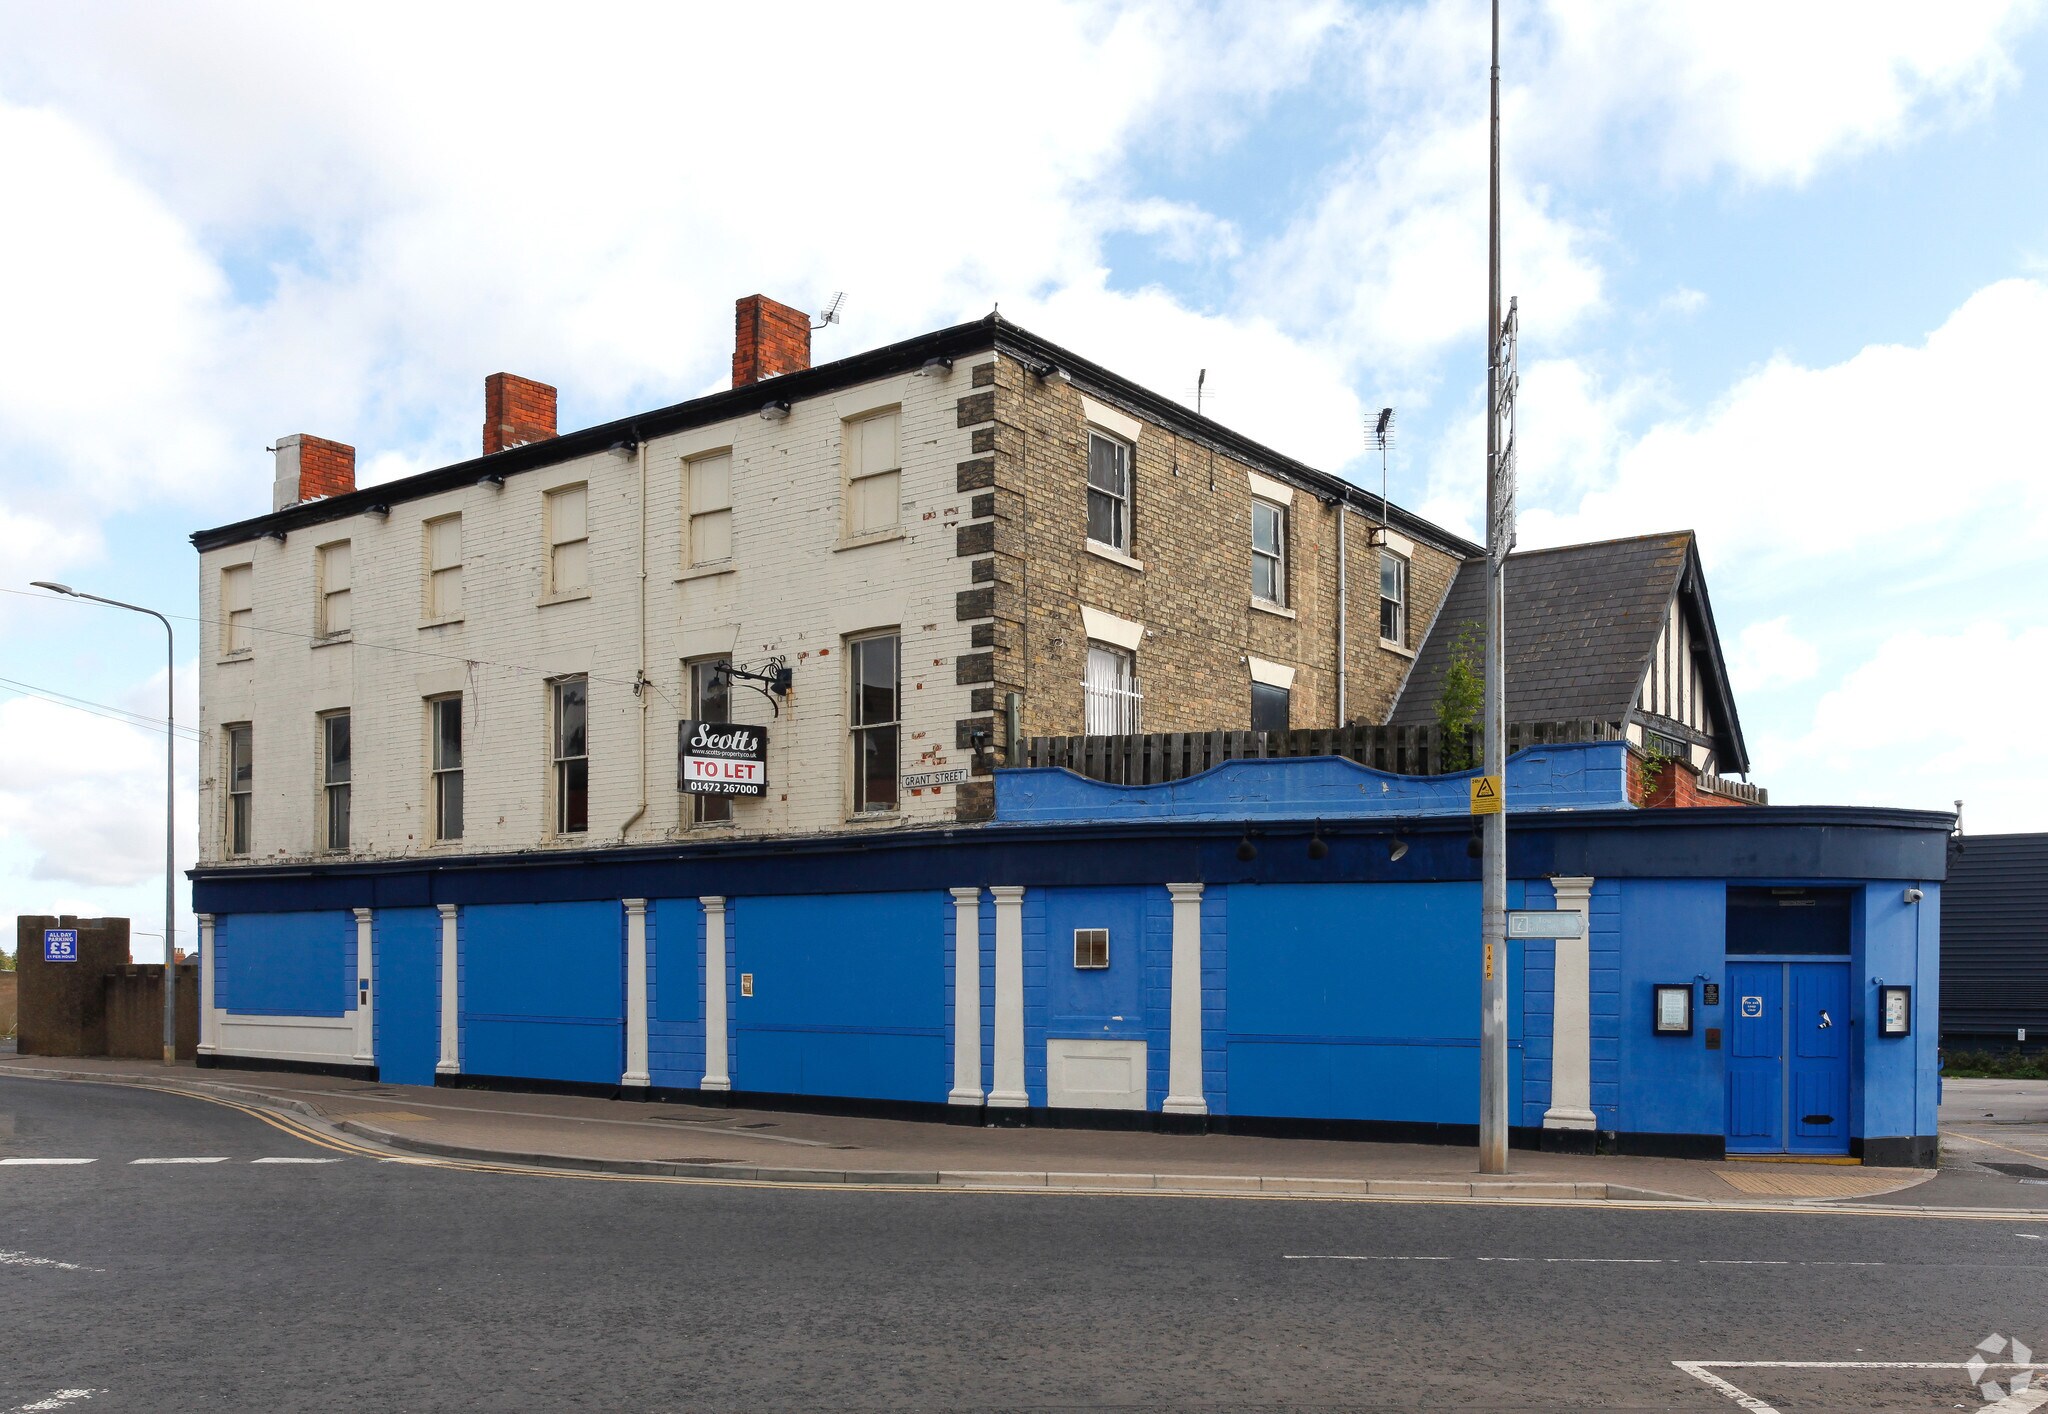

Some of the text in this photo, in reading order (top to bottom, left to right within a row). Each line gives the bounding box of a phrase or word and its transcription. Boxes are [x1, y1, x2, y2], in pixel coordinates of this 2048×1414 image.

[690, 723, 758, 751] Scotts
[691, 748, 757, 758] www.scotts-property.co.uk
[693, 761, 756, 779] TO LET
[905, 771, 964, 786] GRANT STREET
[690, 781, 758, 794] 01472 267000
[50, 942, 71, 955] £5
